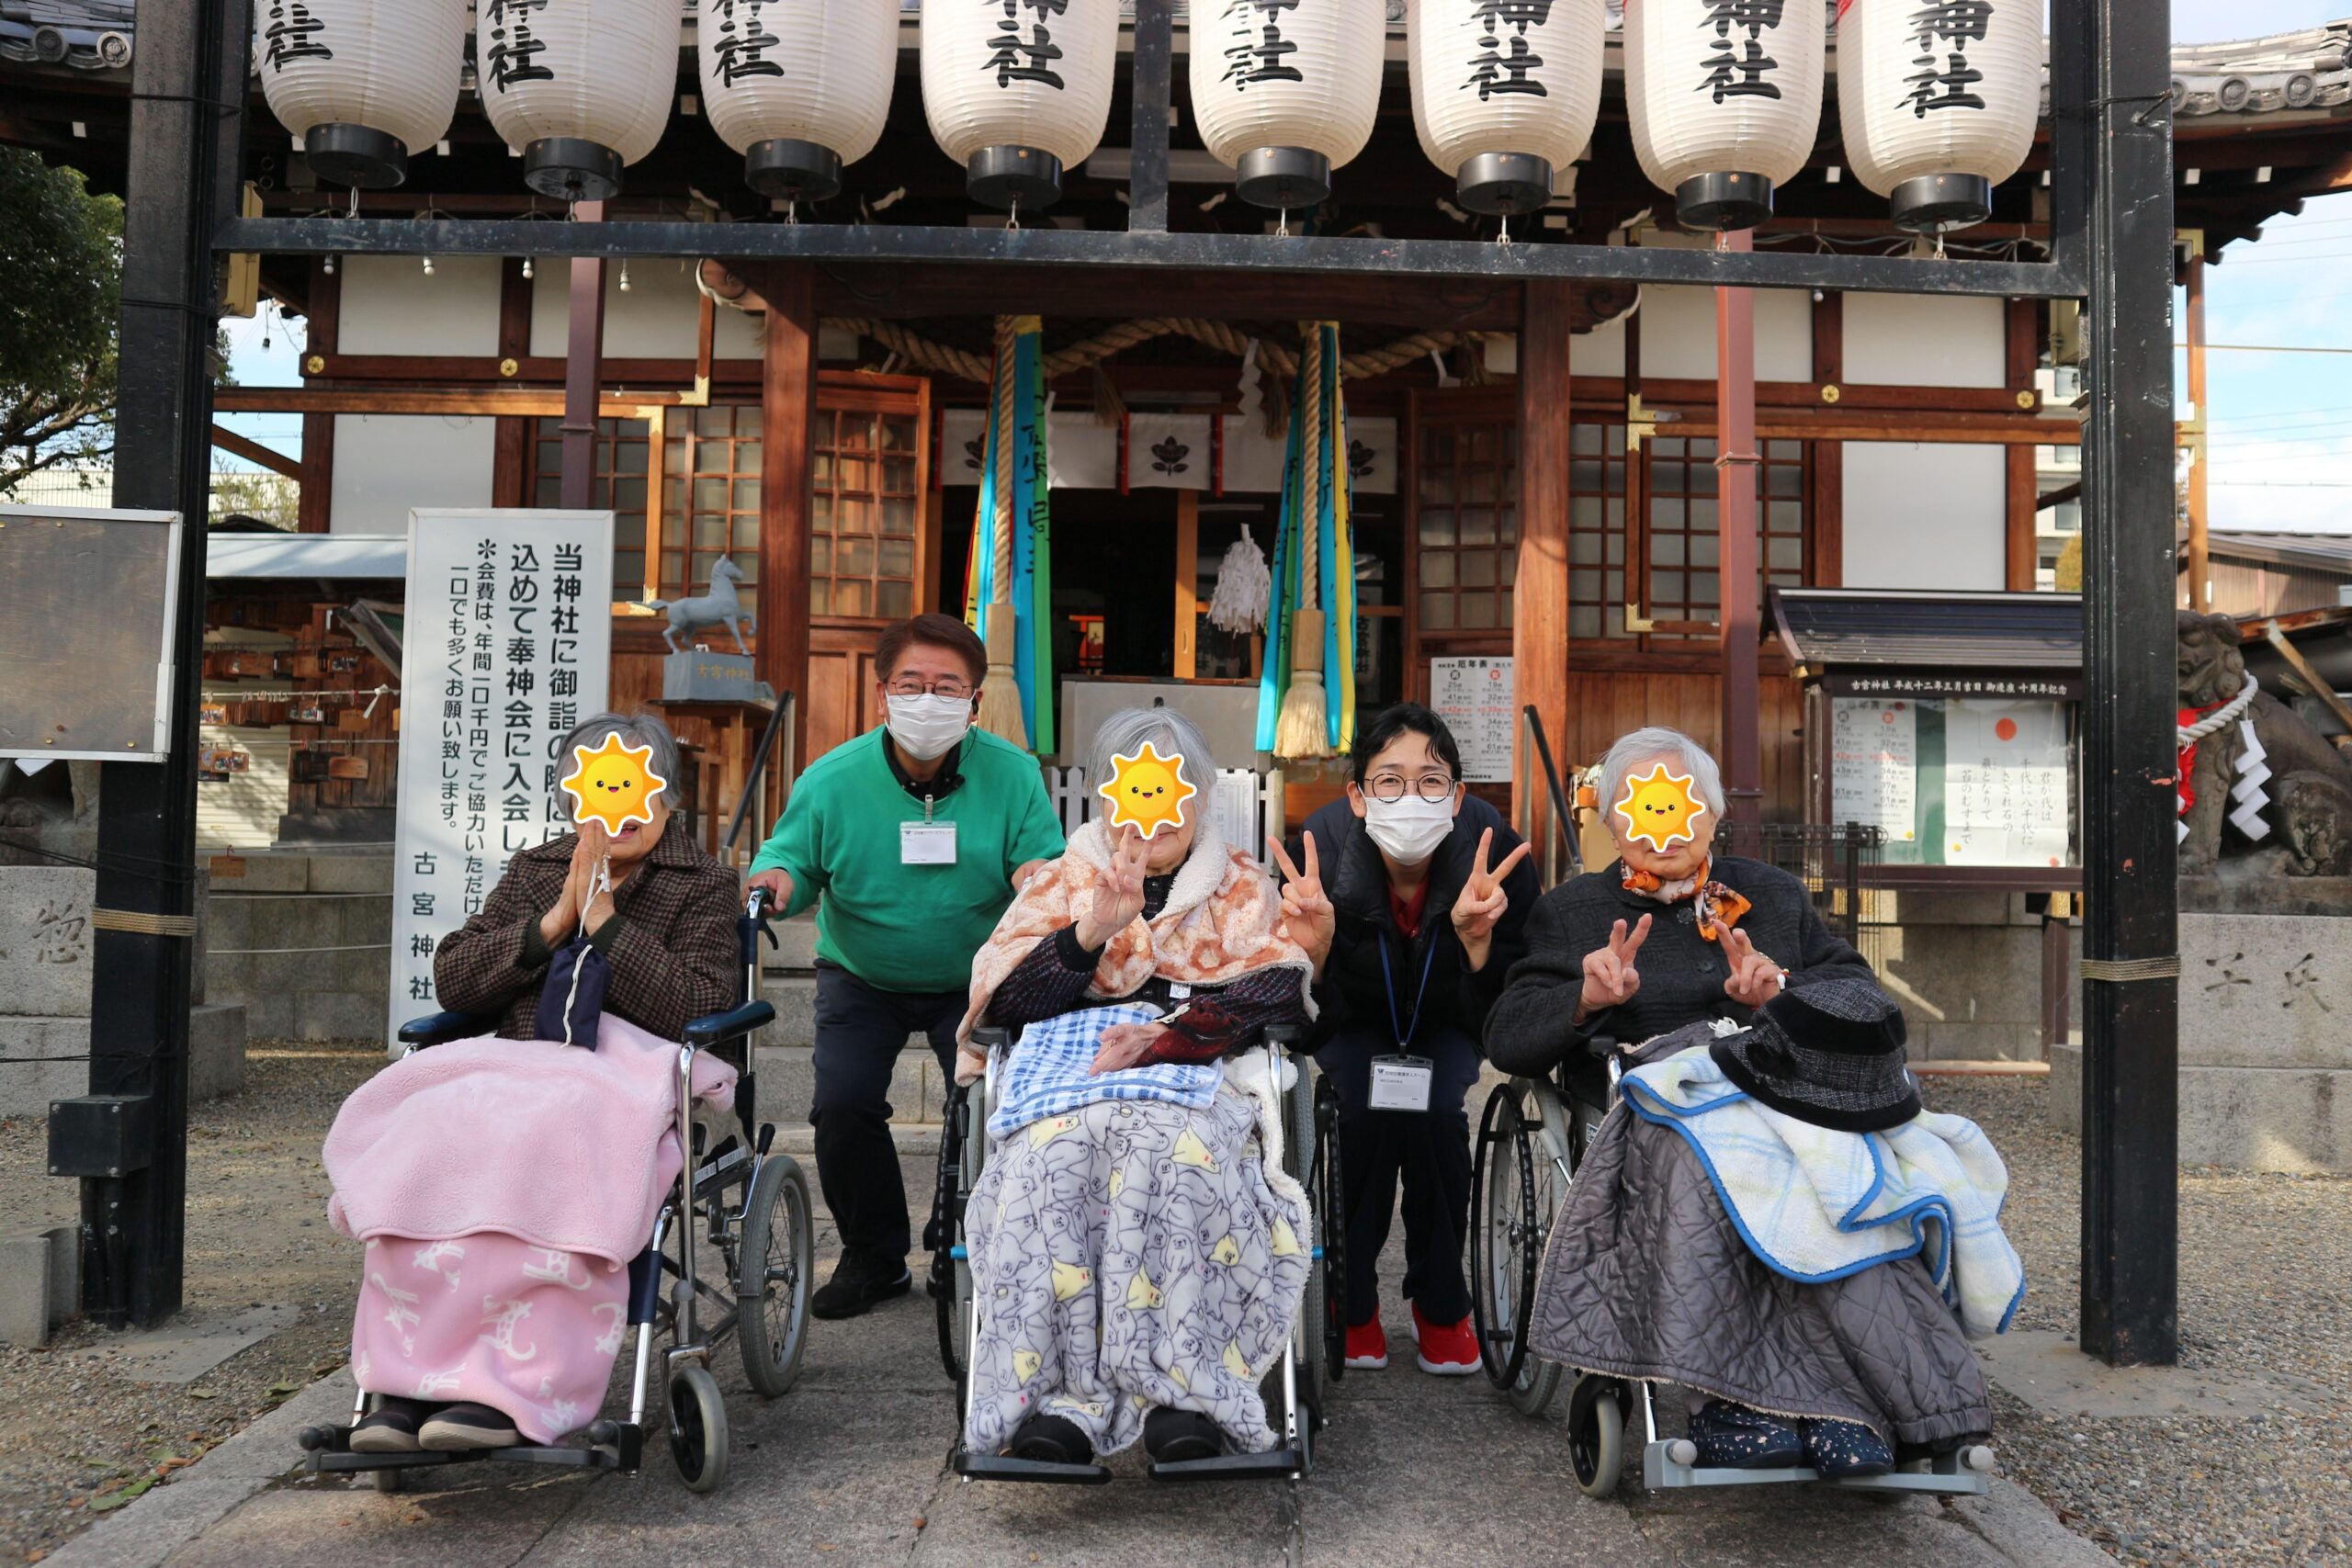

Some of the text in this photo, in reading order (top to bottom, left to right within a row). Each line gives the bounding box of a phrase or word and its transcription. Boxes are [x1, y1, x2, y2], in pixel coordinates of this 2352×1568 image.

[265, 0, 334, 73] 社
[712, 0, 785, 89] 社
[1692, 0, 1786, 106] 神社
[1894, 0, 1995, 118] 神社
[440, 566, 469, 829] 一口でも多くお願い致します。
[463, 538, 497, 919] 会費は、年間一口千円でご協力いただけ
[2041, 772, 2053, 821] 君が代は
[409, 852, 437, 1001] 古宮神社
